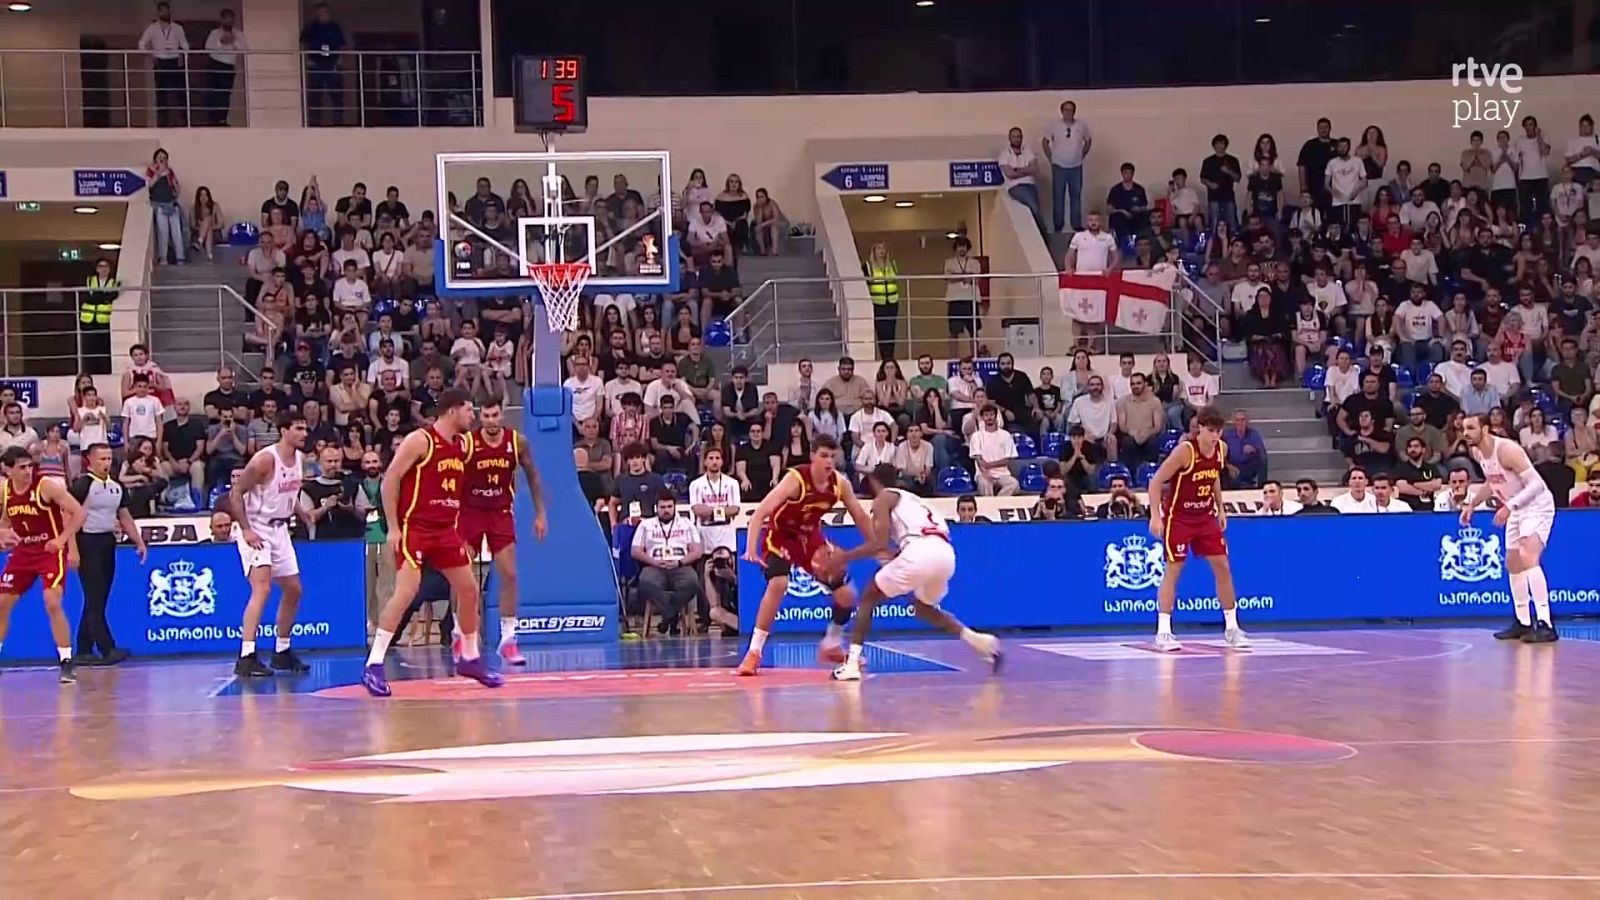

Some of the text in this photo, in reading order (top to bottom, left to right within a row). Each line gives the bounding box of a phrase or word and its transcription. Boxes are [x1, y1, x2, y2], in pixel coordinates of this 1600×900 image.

[555, 60, 577, 79] 39
[551, 83, 576, 123] 5
[845, 175, 853, 188] 6
[984, 171, 992, 183] 8
[114, 181, 122, 194] 6
[22, 391, 31, 406] 5
[441, 477, 456, 491] 44
[487, 474, 499, 484] 14
[1197, 484, 1211, 496] 32
[22, 520, 29, 532] 1
[140, 524, 198, 543] BA
[1549, 589, 1600, 602] ნისტრ
[1104, 595, 1273, 612] სპორტ სამინტრო
